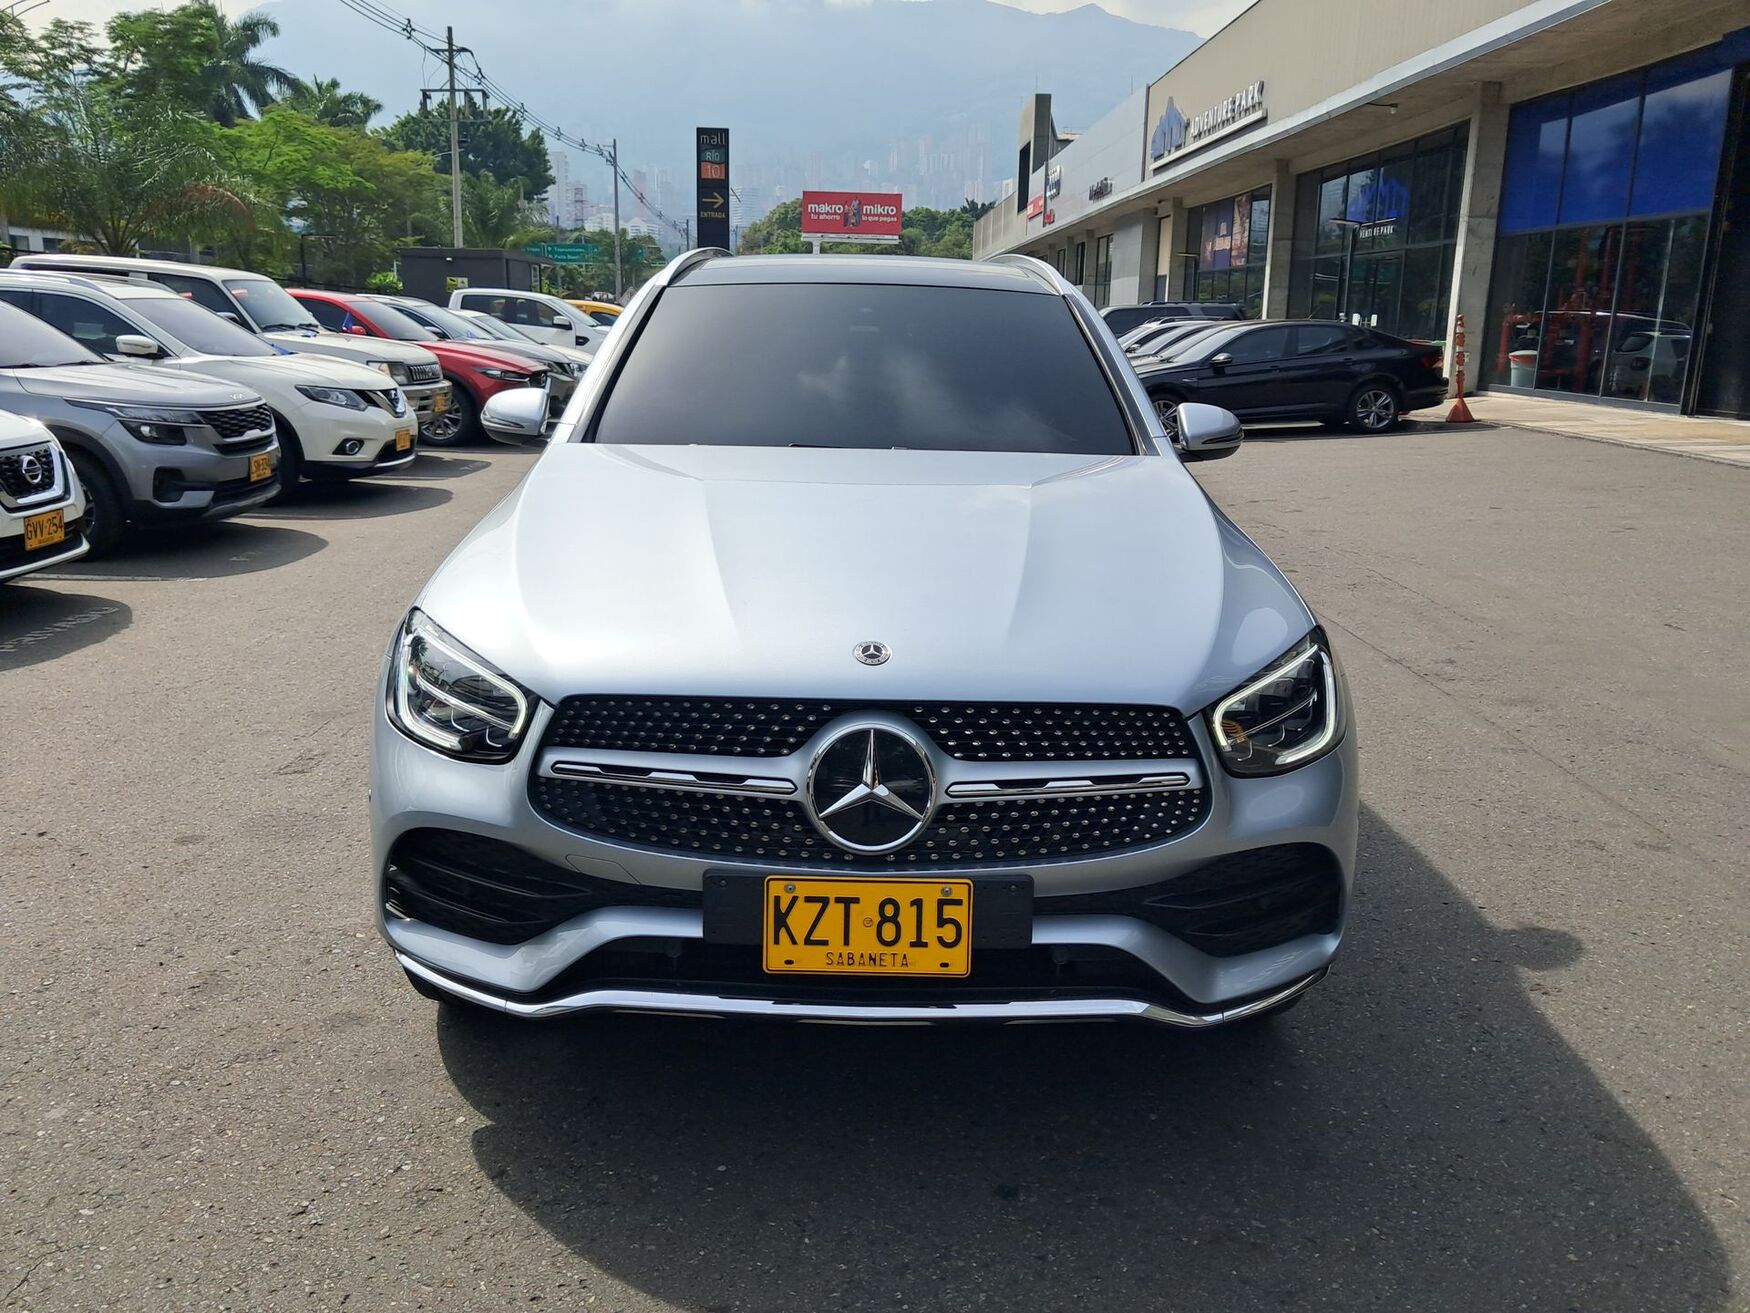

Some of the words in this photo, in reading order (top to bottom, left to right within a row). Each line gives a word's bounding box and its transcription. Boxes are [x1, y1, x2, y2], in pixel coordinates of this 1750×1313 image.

[1190, 97, 1234, 137] ADVENTURE
[1235, 81, 1264, 111] PARK
[700, 132, 725, 145] mall
[707, 164, 721, 177] 10
[808, 202, 844, 213] makro
[863, 204, 897, 215] mikro
[26, 519, 45, 540] GVV
[46, 515, 63, 536] 254
[773, 895, 861, 947] KZT
[876, 897, 963, 949] 815
[825, 951, 910, 968] SABANETA
